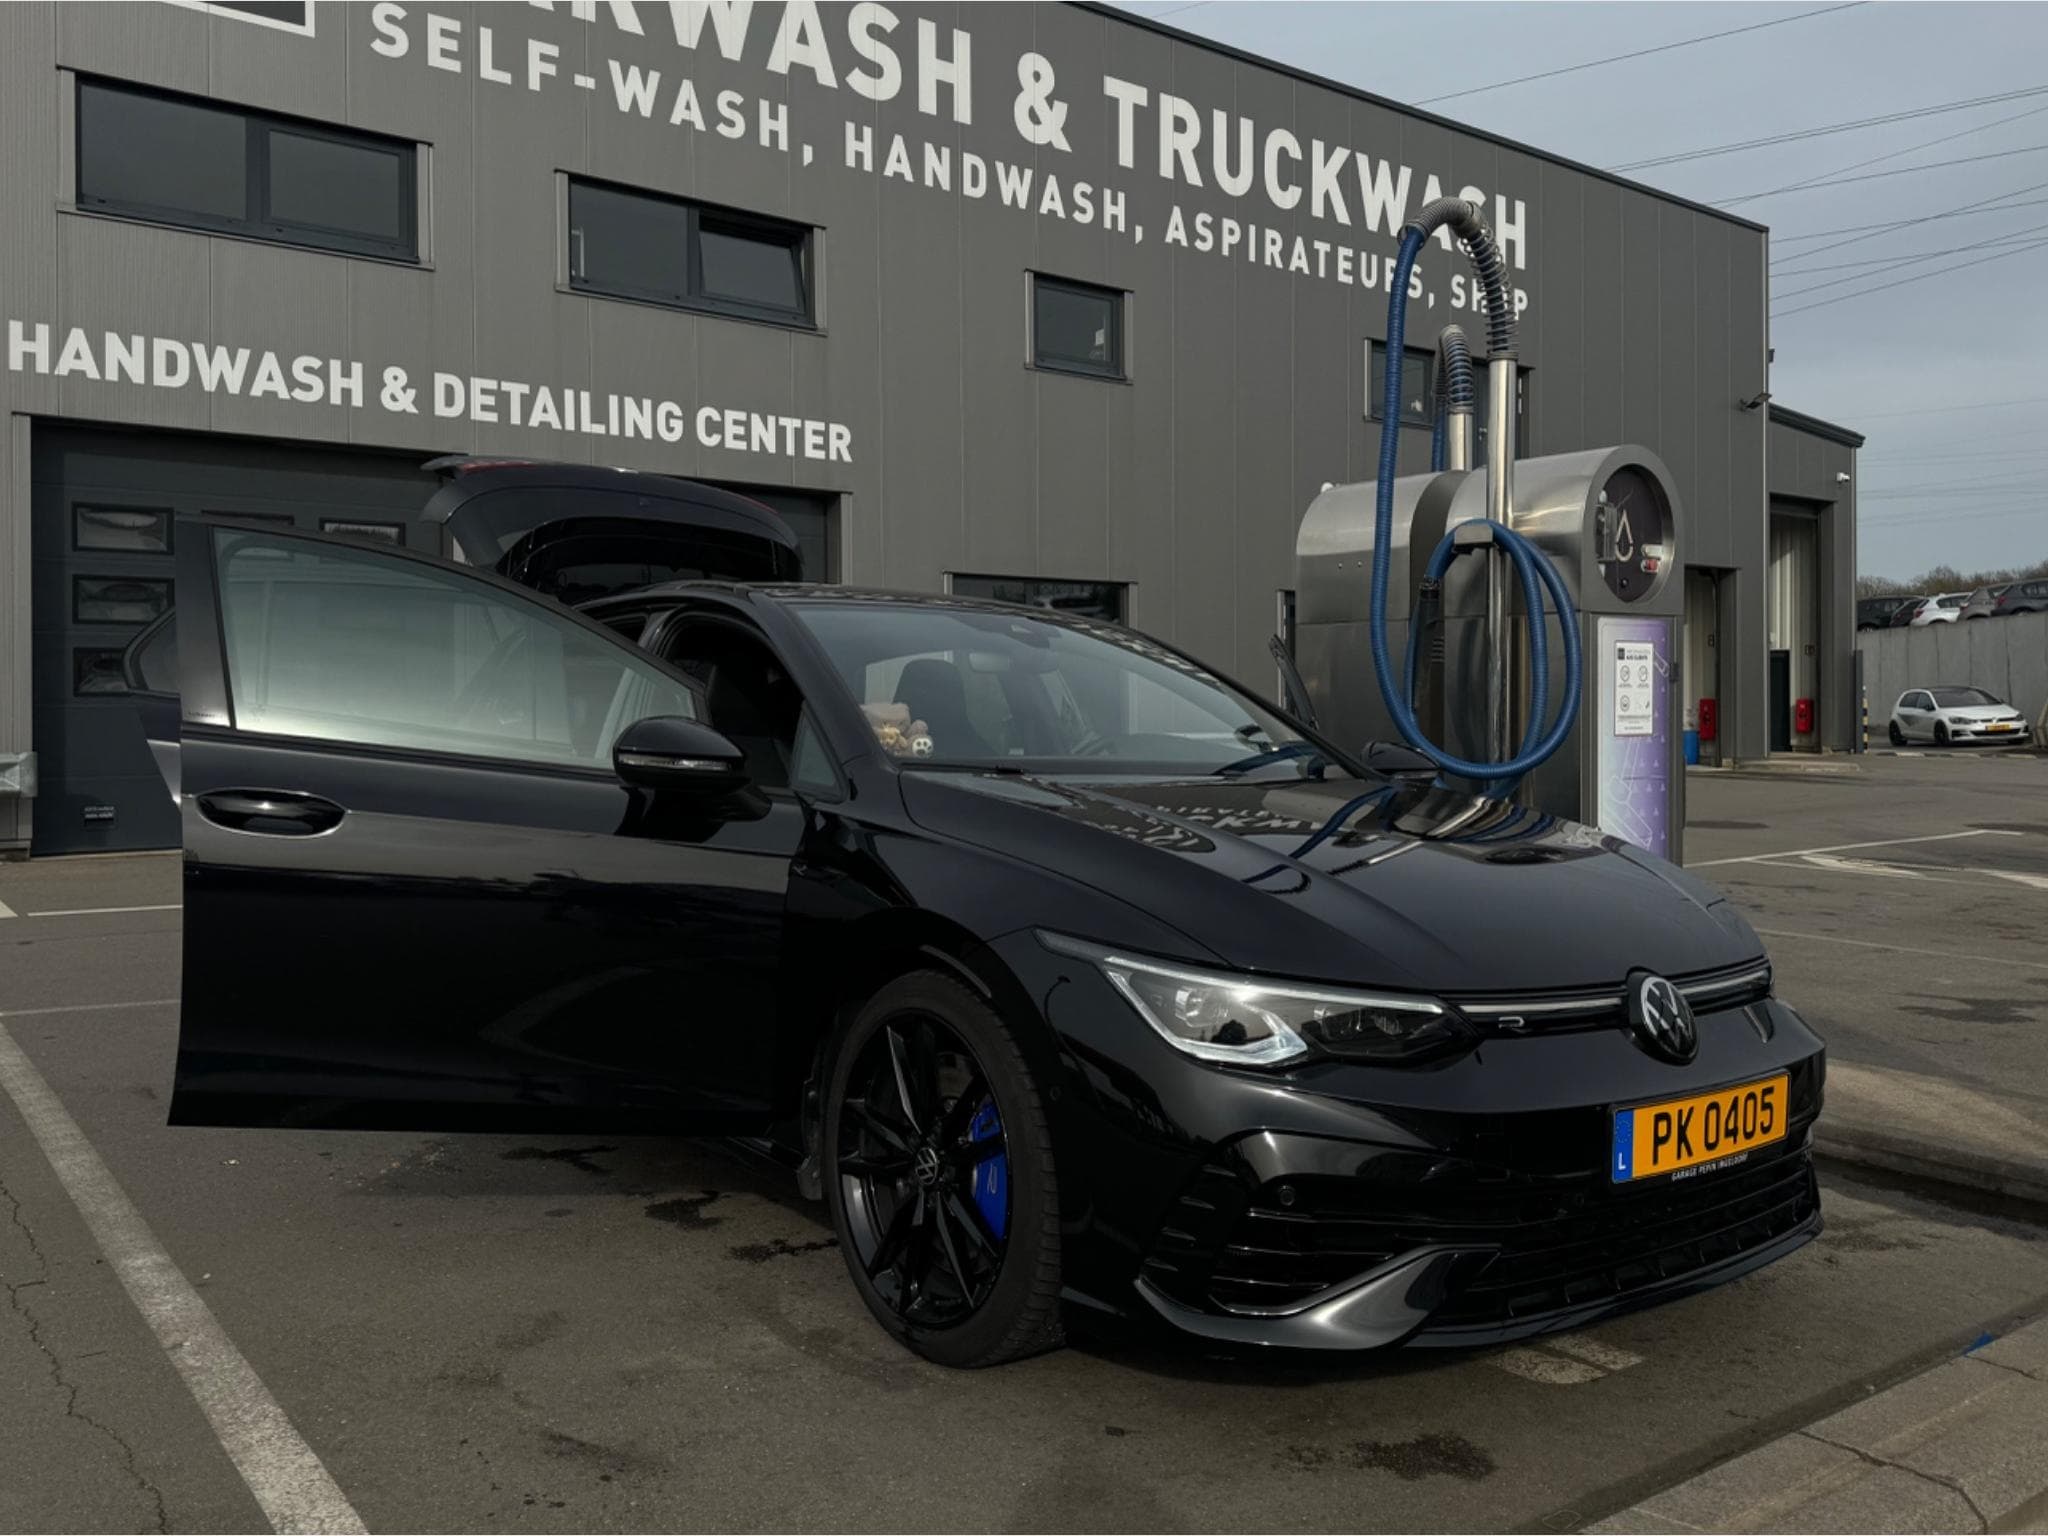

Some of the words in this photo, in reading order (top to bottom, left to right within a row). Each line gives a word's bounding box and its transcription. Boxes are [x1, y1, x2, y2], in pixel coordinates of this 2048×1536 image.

[1014, 52, 1073, 152] &
[370, 2, 813, 166] SELF-WASH,
[845, 121, 1143, 244] HANDWASH,
[1450, 274, 1529, 321] SHP
[8, 319, 363, 408] HANDWASH
[380, 366, 419, 414] &
[433, 372, 684, 442] DETAILING
[696, 406, 852, 462] CENTER
[1617, 1151, 1627, 1171] L
[1652, 1106, 1694, 1165] PK
[1704, 1086, 1775, 1152] 0405
